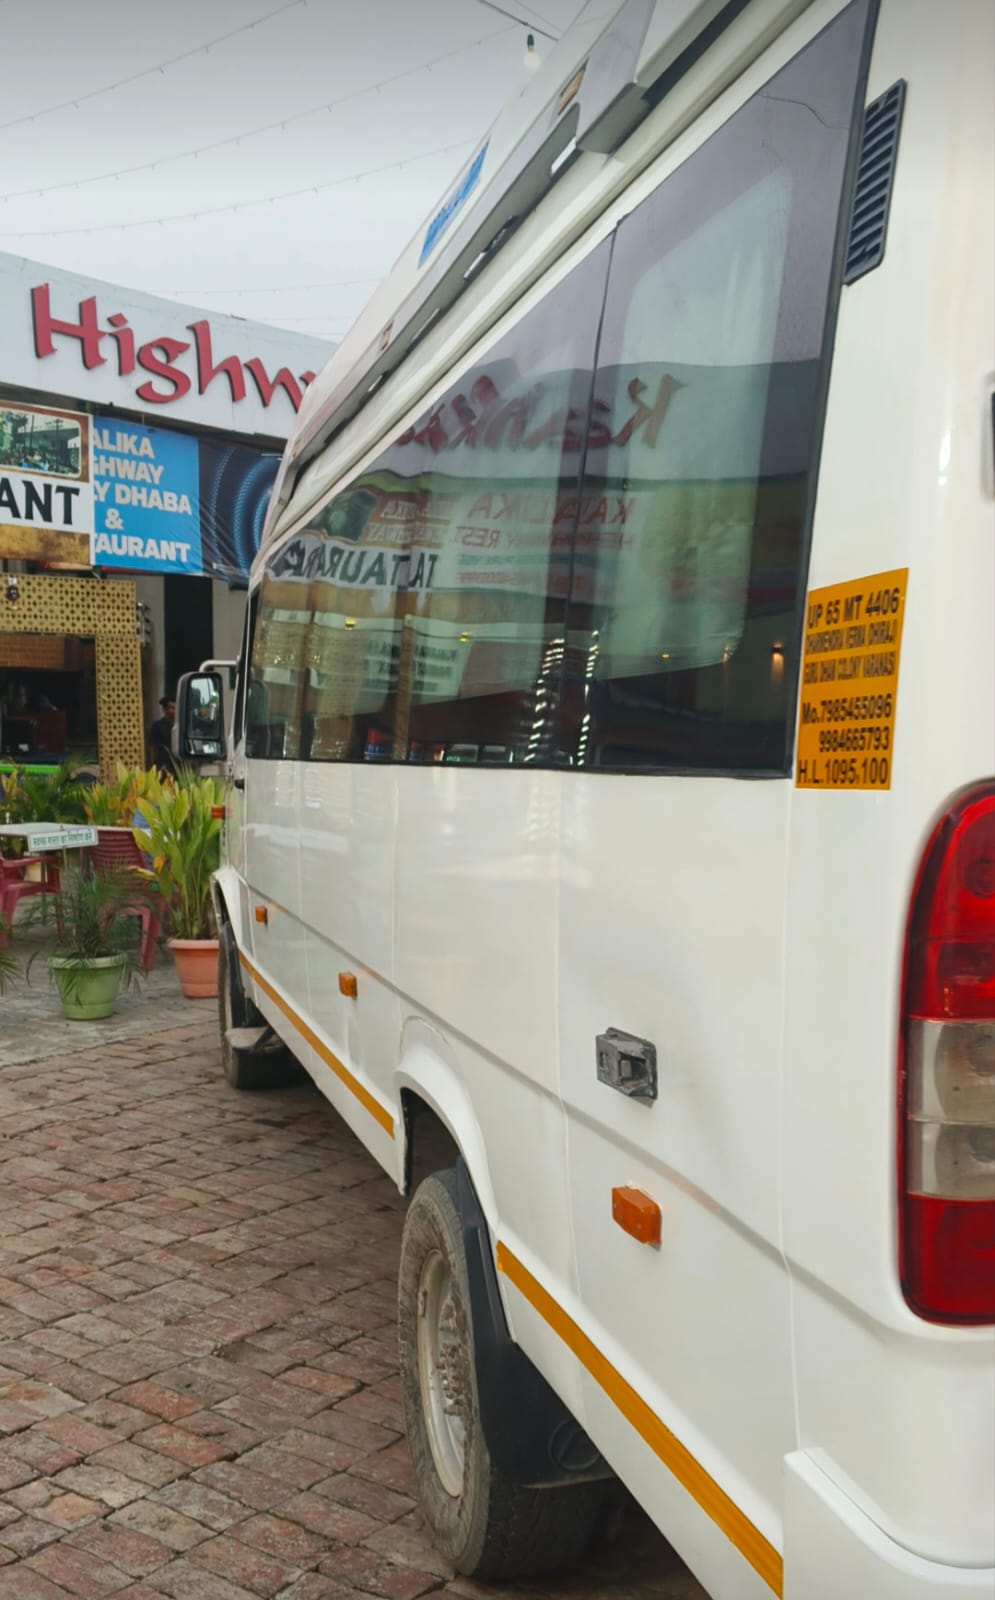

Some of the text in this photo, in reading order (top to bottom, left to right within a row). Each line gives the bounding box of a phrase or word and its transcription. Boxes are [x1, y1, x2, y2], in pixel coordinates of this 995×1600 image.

[94, 481, 192, 515] Y DHABA
[104, 508, 124, 530] &
[94, 533, 191, 562] AURANT
[808, 587, 900, 628] UP 65 MT 4406
